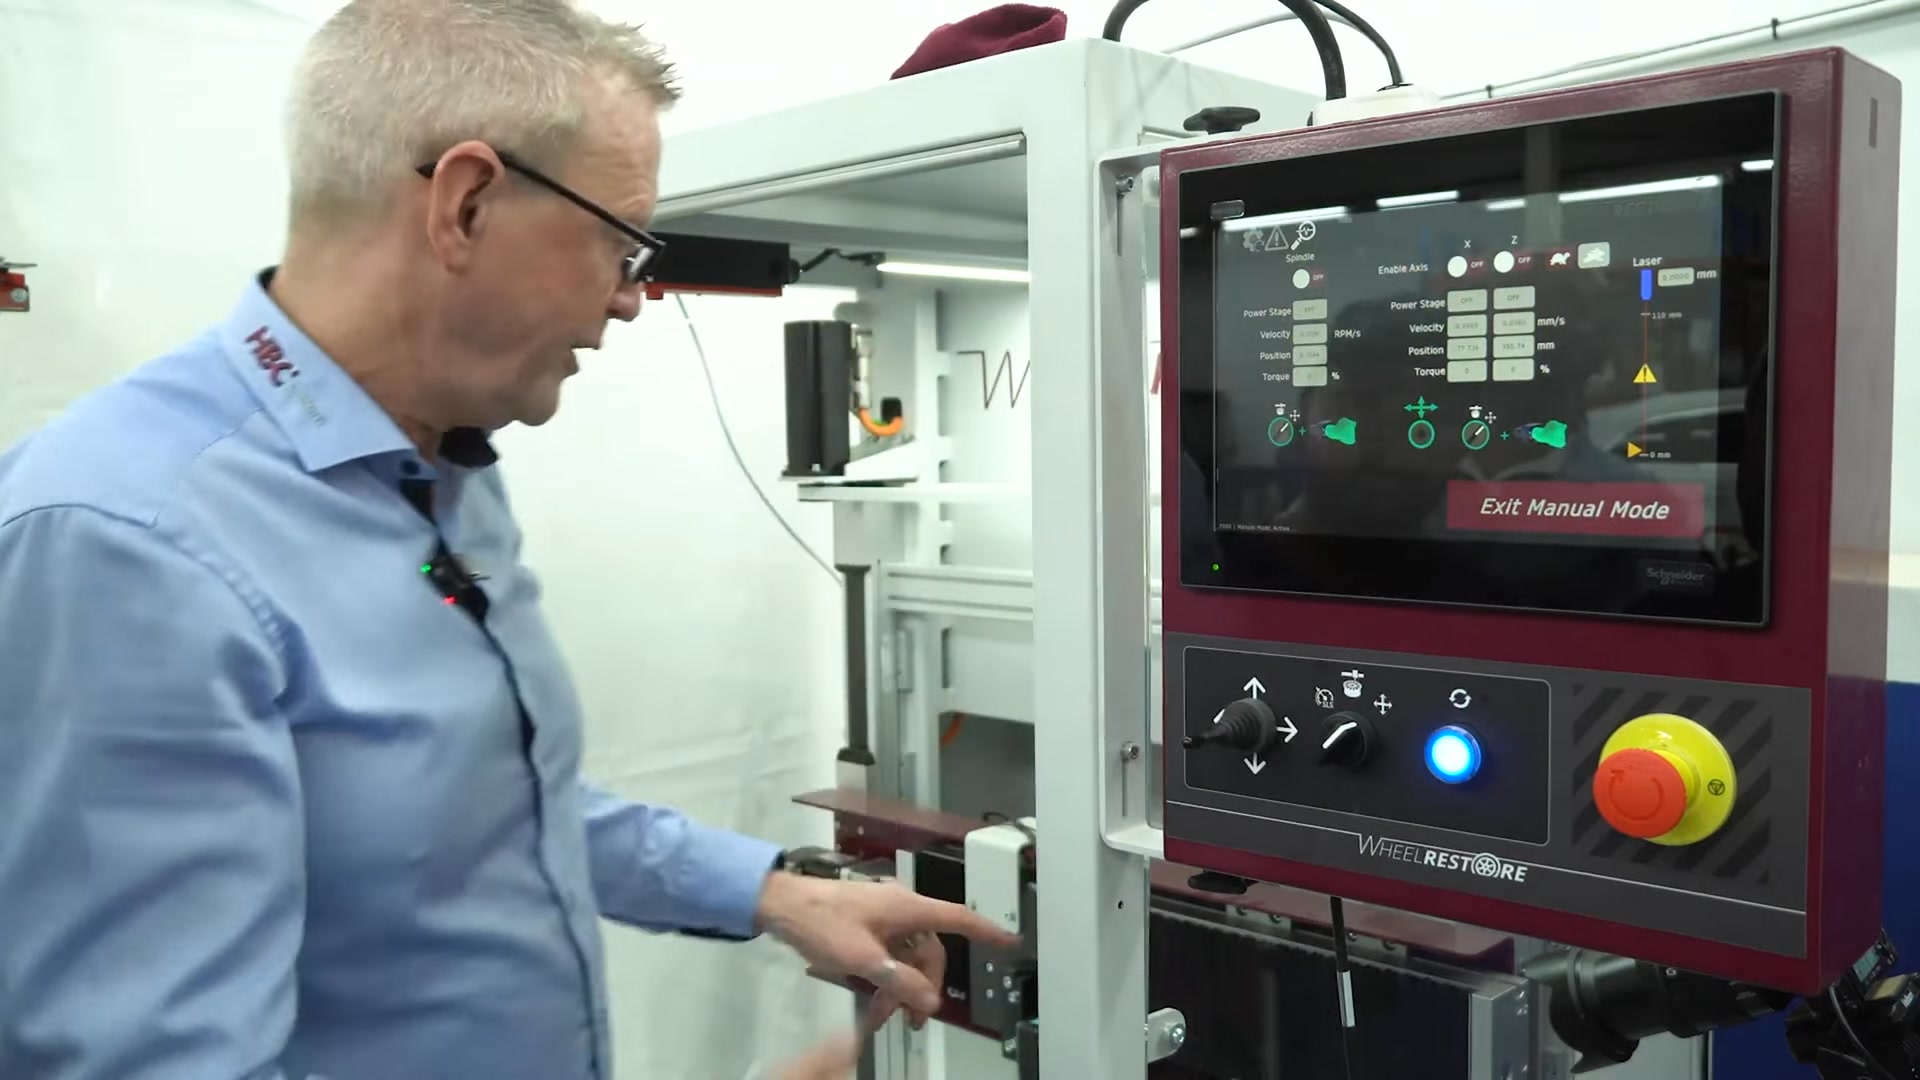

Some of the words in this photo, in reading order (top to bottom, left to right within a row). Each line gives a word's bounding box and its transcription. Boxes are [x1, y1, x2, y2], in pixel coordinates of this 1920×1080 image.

[1464, 240, 1471, 248] X
[1511, 235, 1518, 245] Z
[1285, 251, 1315, 263] Spindle
[1518, 256, 1531, 264] OFF
[1632, 256, 1662, 267] Laser
[1378, 266, 1407, 275] Enable
[1409, 263, 1429, 273] Axis
[1471, 260, 1484, 269] OFF
[1697, 270, 1717, 279] mm
[1390, 301, 1418, 310] Power
[1419, 299, 1446, 310] Stage
[1243, 308, 1267, 318] Power
[1269, 307, 1291, 318] Stage
[1652, 311, 1666, 319] 110
[1537, 316, 1566, 326] mm/s
[1409, 323, 1445, 334] Velocity
[1260, 329, 1291, 340] Velocity
[1334, 329, 1361, 340] RPM/s
[1408, 346, 1444, 355] Position
[1537, 342, 1555, 350] mm
[244, 325, 295, 388] HBC
[1260, 351, 1291, 361] Position
[1414, 367, 1446, 377] Torque
[1540, 364, 1550, 374] %
[1262, 372, 1290, 382] Torque
[1332, 371, 1340, 380] %
[1480, 497, 1522, 516] Exit
[1527, 498, 1604, 518] Manual
[1610, 500, 1670, 520] Mode
[1646, 567, 1705, 586] Schneider
